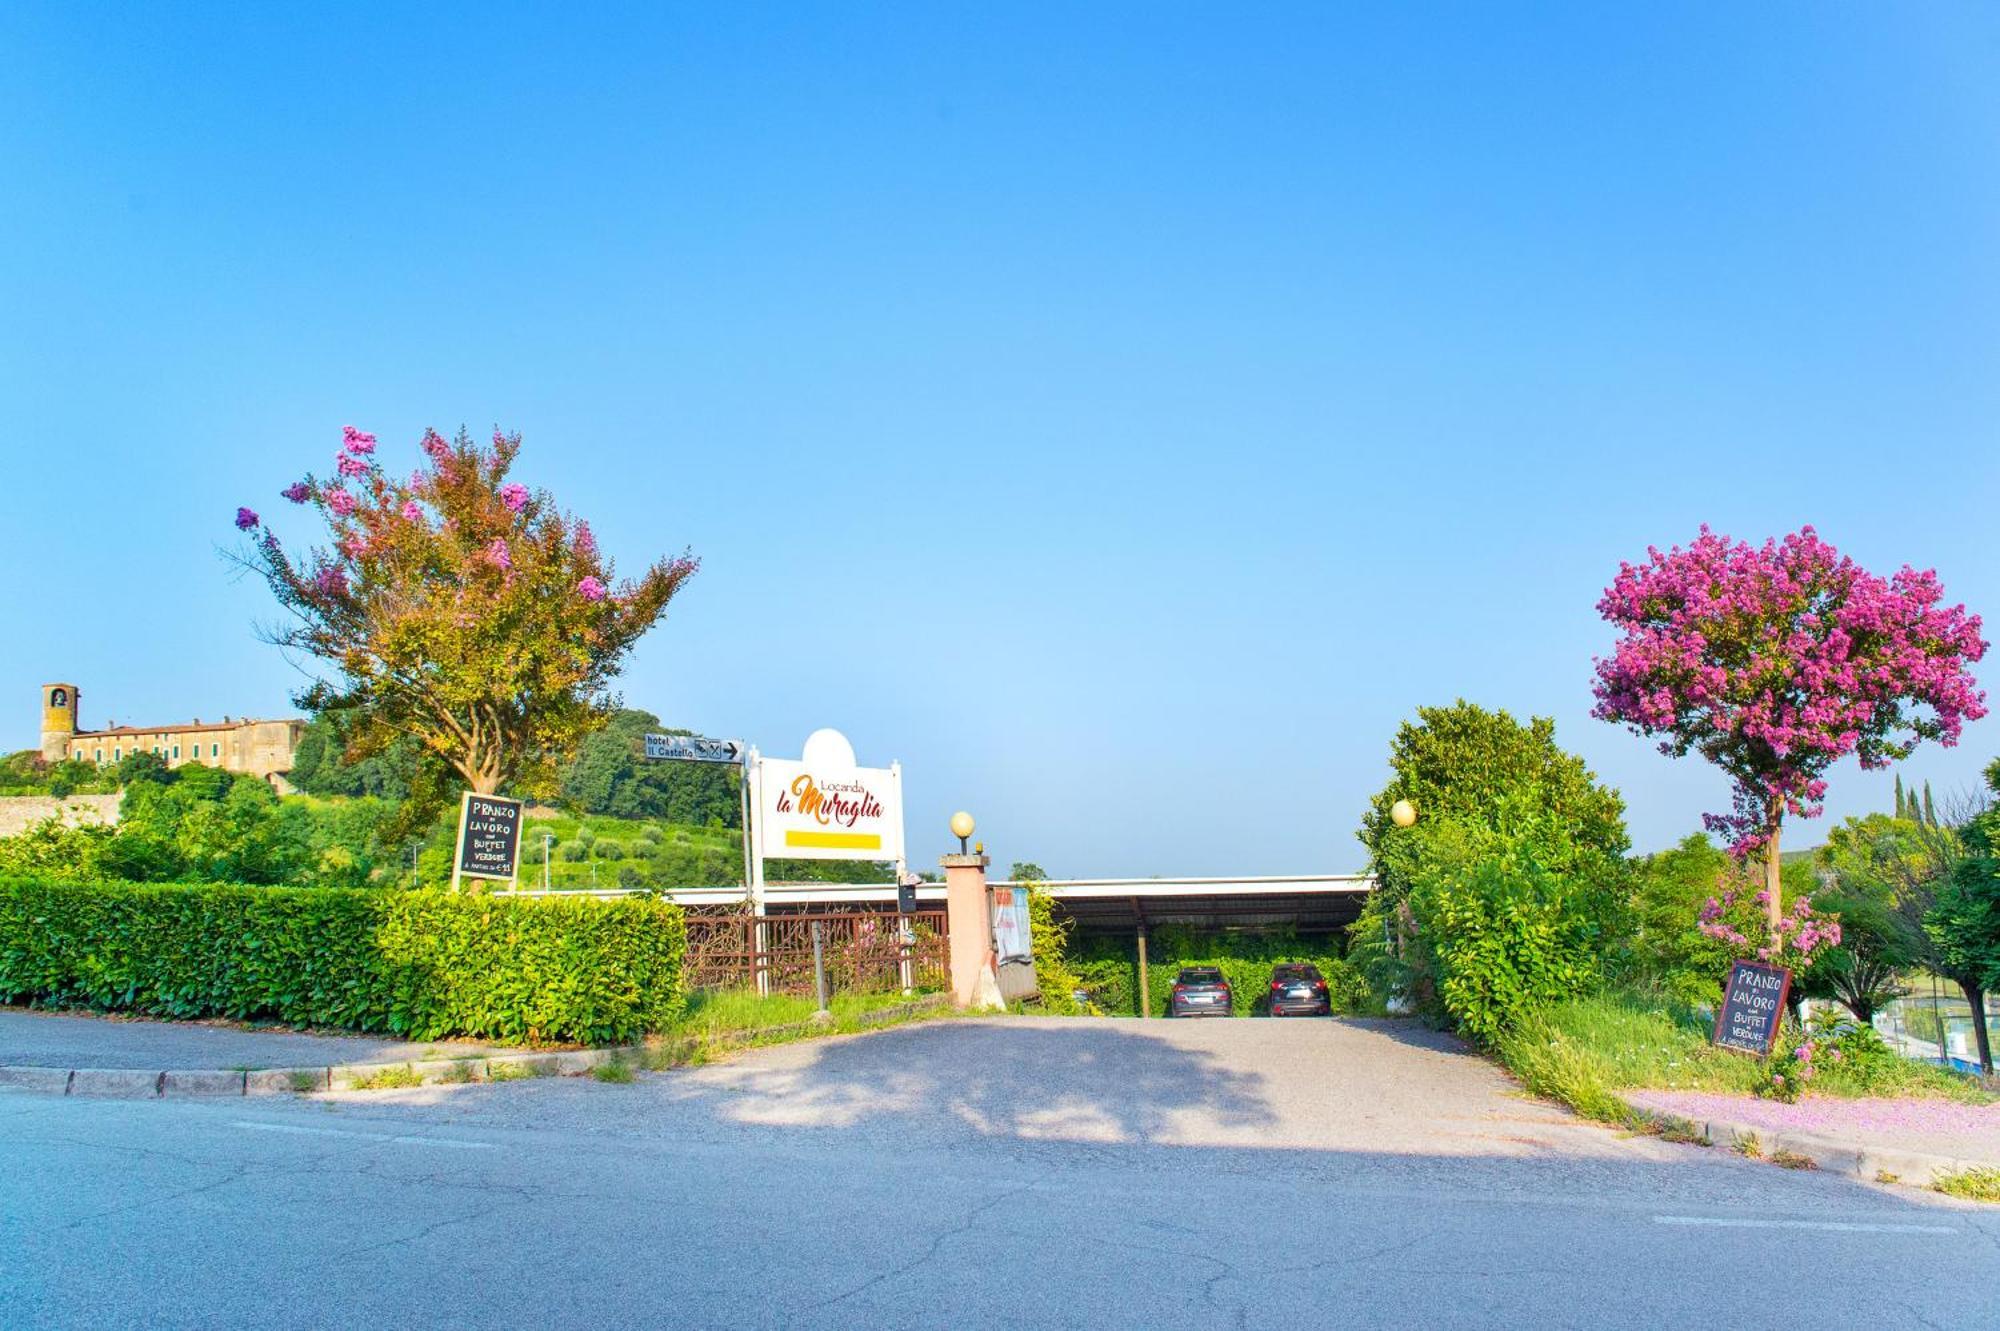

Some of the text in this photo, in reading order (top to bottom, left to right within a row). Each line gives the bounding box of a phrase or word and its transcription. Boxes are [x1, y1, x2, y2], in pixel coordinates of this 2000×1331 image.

[647, 736, 669, 745] hotel
[658, 747, 693, 757] Castello
[821, 780, 865, 793] Locanda
[777, 774, 884, 828] la Muraglia
[473, 802, 515, 818] PRANZO
[469, 821, 511, 834] LAVORO
[474, 839, 506, 849] BUFFET
[1738, 969, 1781, 990] PRANZO
[1732, 990, 1776, 1011] LAVORO
[1734, 1011, 1768, 1028] BUFFET
[1732, 1026, 1765, 1041] VERDURE
